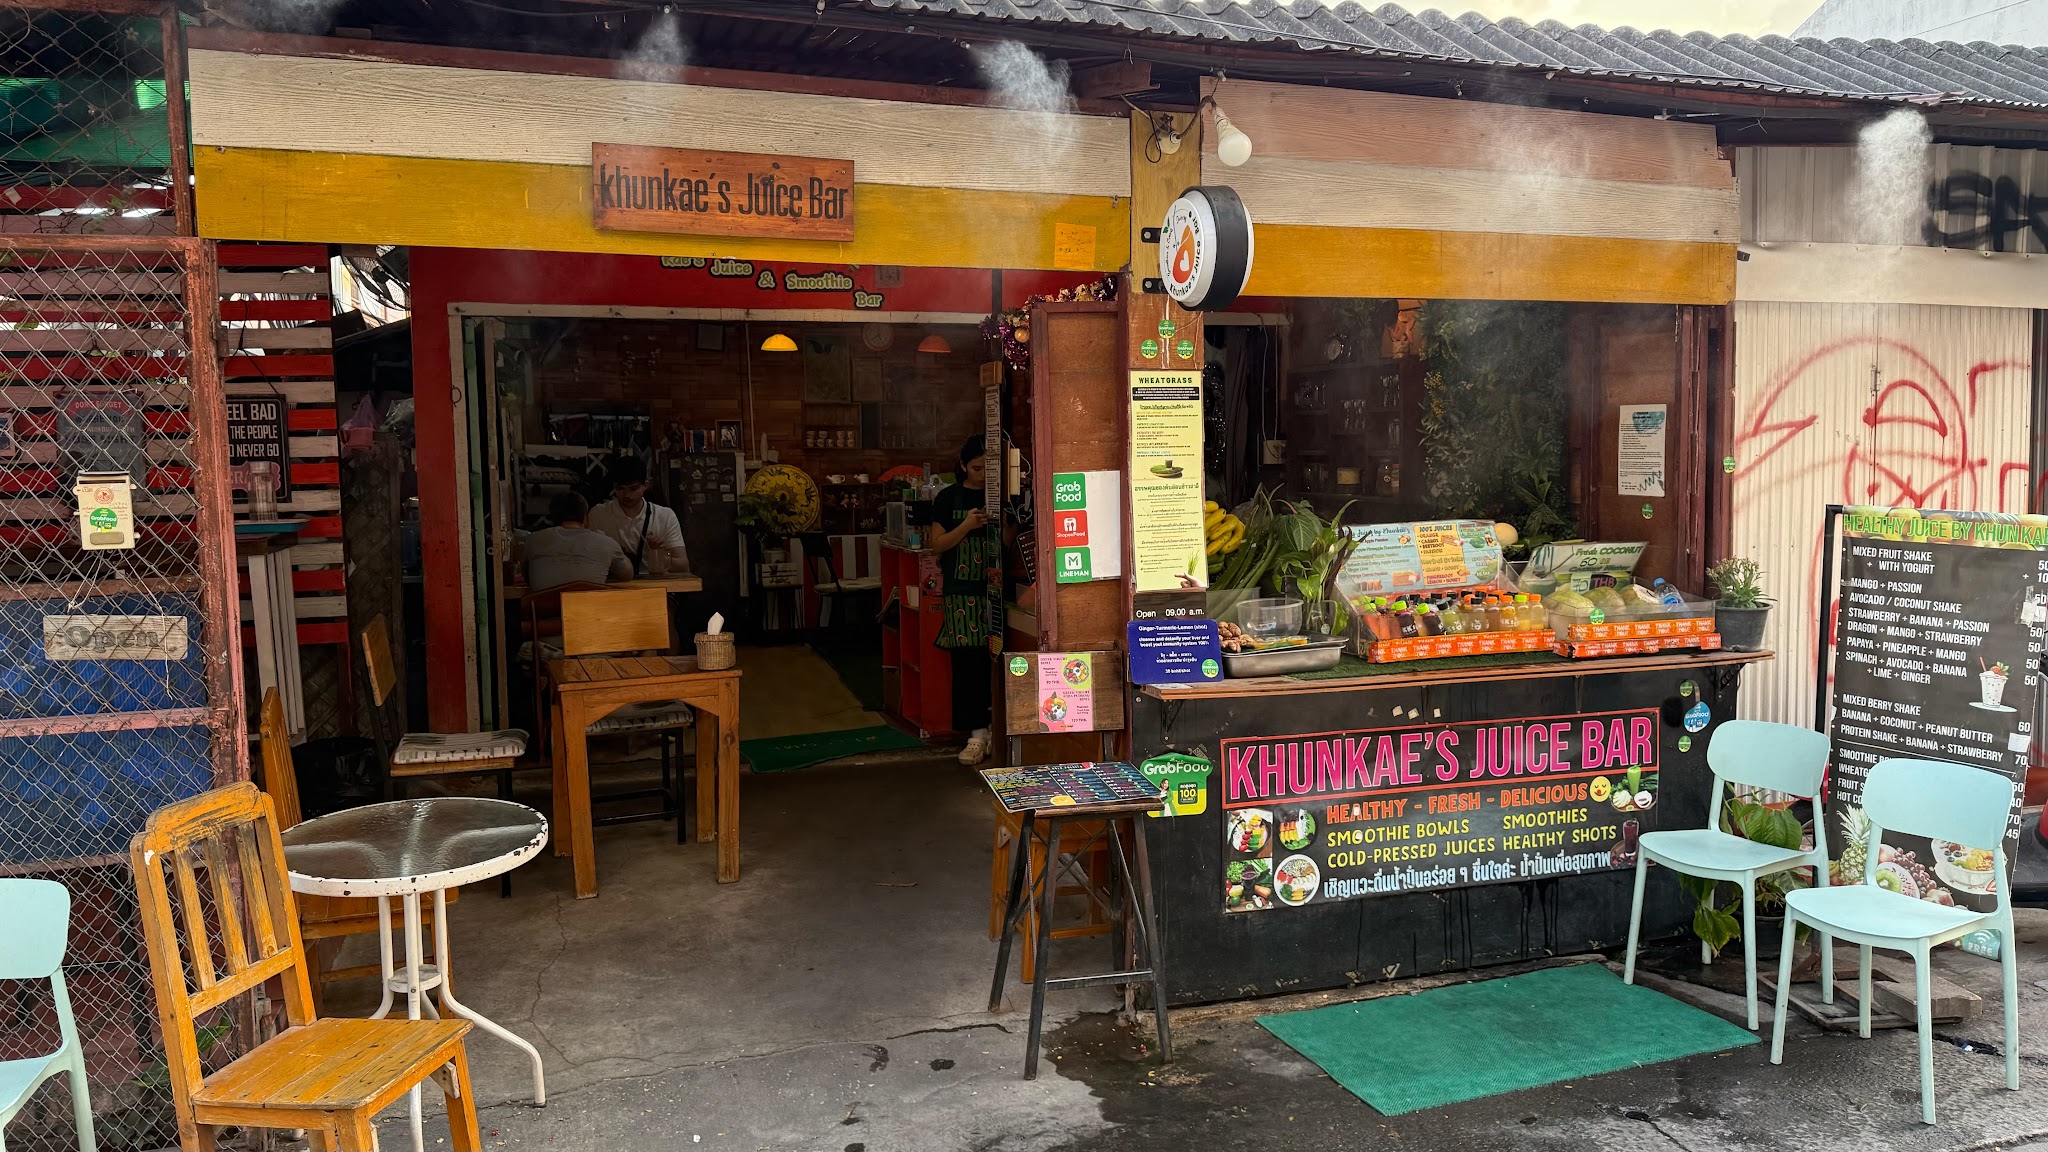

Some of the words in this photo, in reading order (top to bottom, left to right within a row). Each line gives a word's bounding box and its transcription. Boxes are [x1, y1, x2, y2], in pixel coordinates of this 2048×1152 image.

[738, 173, 802, 218] Juice
[810, 176, 848, 219] Bar
[711, 259, 752, 276] Juice
[758, 270, 776, 288] &
[786, 274, 852, 290] Smoothie
[854, 292, 882, 309] Bar
[227, 404, 247, 420] EEL
[250, 404, 276, 420] BAD
[230, 425, 246, 439] THE
[247, 425, 278, 439] PEOPLE
[237, 444, 264, 457] NEVER
[267, 444, 280, 456] GO
[1056, 481, 1081, 492] Grab
[1056, 492, 1081, 502] Food
[1844, 514, 1905, 535] HEALTHY
[1907, 520, 1949, 538] JUICE
[1951, 521, 1972, 539] BY
[1975, 522, 2018, 544] KHUN
[1600, 546, 1643, 555] COCONUT
[1853, 546, 1876, 558] MIXED
[1879, 548, 1902, 560] FRUIT
[1904, 550, 1932, 561] SHAKE
[1879, 561, 1900, 572] WITH
[1902, 562, 1935, 574] YOGURT
[1593, 577, 1614, 588] THB
[2038, 573, 2048, 583] 10
[1850, 578, 1878, 589] MANGO
[1888, 582, 1922, 594] PASSION
[1850, 592, 1885, 605] AVOCADO
[1894, 597, 1931, 610] COCONUT
[1933, 601, 1962, 613] SHAKE
[2035, 594, 2046, 604] 50
[1136, 610, 1156, 619] Open
[1166, 608, 1186, 617] 09.00
[1849, 608, 1901, 622] STRAWBERRY
[1910, 615, 1943, 628] BANANA
[1953, 620, 1990, 633] PASSION
[1848, 621, 1878, 633] DRAGON
[1887, 626, 1916, 638] MANGO
[1925, 631, 1982, 647] STRAWBERRY
[2030, 627, 2042, 637] 50
[1847, 636, 1874, 649] PAPAYA
[1883, 642, 1926, 657] PINEAPPLE
[1936, 649, 1966, 661] MANGO
[2028, 642, 2040, 652] 50
[1846, 651, 1877, 664] SPINACH
[1886, 657, 1923, 671] AVOCADO
[1933, 664, 1967, 677] BANANA
[2026, 659, 2038, 669] 50
[1874, 667, 1892, 678] LIME
[1901, 672, 1931, 684] GINGER
[2024, 675, 2037, 686] 50
[1843, 694, 1866, 707] MIXED
[1868, 698, 1892, 710] BERRY
[1894, 702, 1921, 716] SHAKE
[1842, 708, 1871, 723] BANANA
[1880, 715, 1917, 730] COCONUT
[1926, 724, 1959, 737] PEANUT
[1960, 728, 1993, 743] BUTTER
[2018, 722, 2030, 732] 60
[1841, 724, 1872, 739] PROTEIN
[1873, 730, 1898, 744] SHAKE
[1906, 736, 1938, 751] BANANA
[1948, 743, 2003, 762] STRAWBERRY
[1230, 726, 1459, 800] KHUNKAE'S
[1469, 723, 1572, 780] JUICE
[1581, 717, 1652, 770] BAR
[1840, 748, 1877, 764] SMOOTHIE
[2015, 755, 2027, 765] 70
[1839, 763, 1869, 777] WHEATG
[1837, 778, 1859, 790] FRUIT
[1180, 789, 1196, 797] 100
[1837, 790, 1852, 802] HOT
[1327, 800, 1407, 824] HEALTHY
[1428, 794, 1480, 813] FRESH
[1500, 783, 1588, 808] DELICIOUS
[1503, 808, 1588, 830] SMOOTHIES
[2008, 814, 2020, 825] 70
[1327, 826, 1410, 848] SMOOTHIE
[1416, 820, 1470, 838] BOWLS
[1502, 831, 1568, 851] HEALTHY
[1572, 826, 1617, 844] SHOTS
[2006, 829, 2018, 839] 45
[1328, 843, 1437, 868] COLD-PRESSED
[1444, 834, 1496, 856] JUICES
[1472, 858, 1516, 882] ชื่นใจค่ะ
[1968, 942, 1993, 956] FREE
